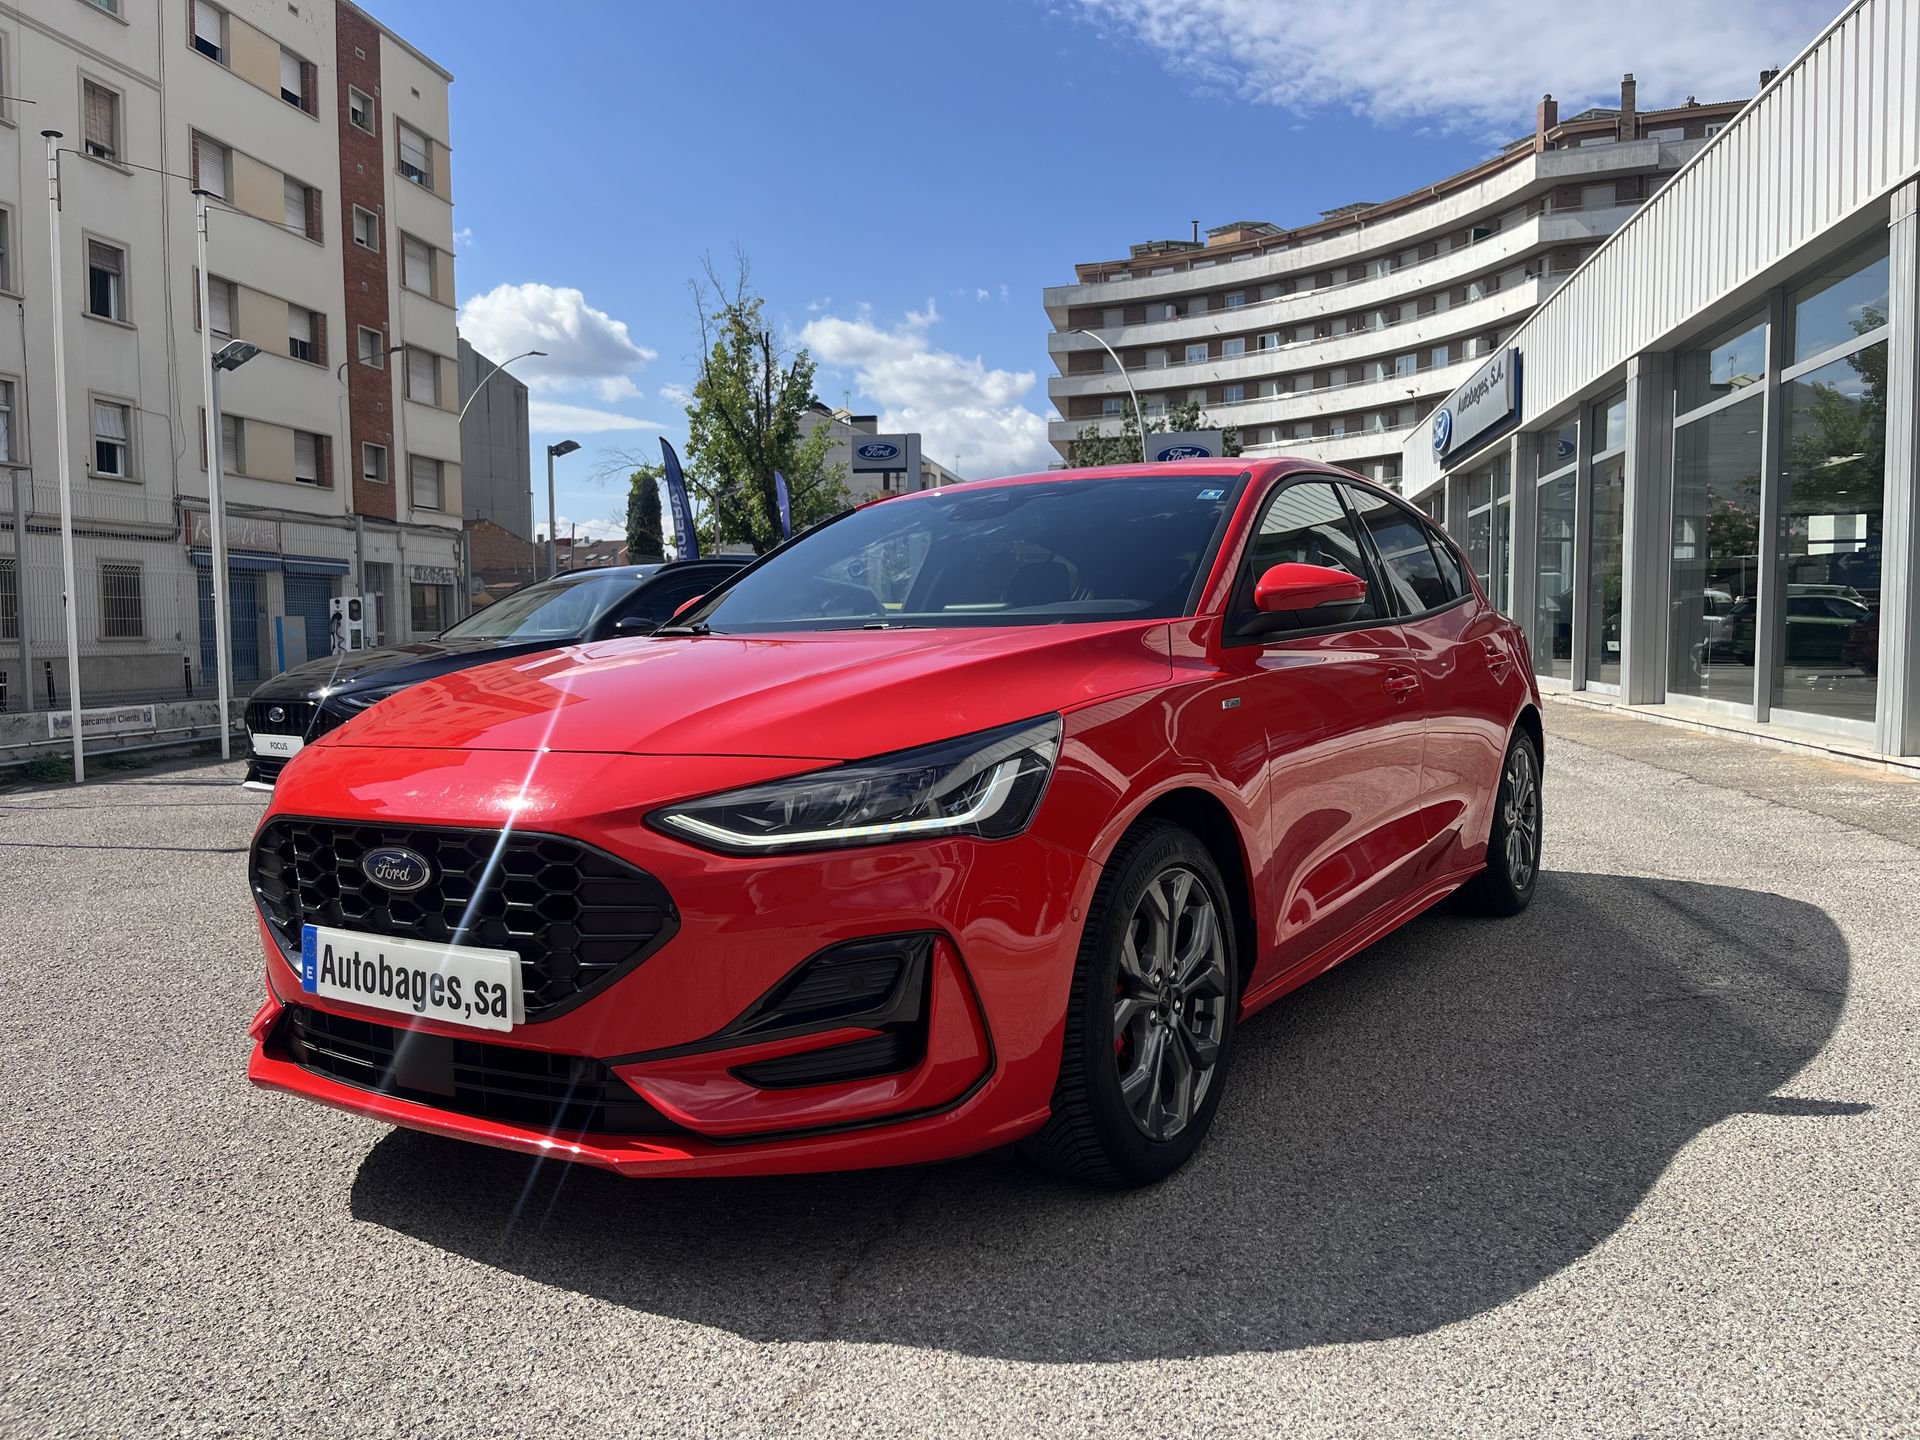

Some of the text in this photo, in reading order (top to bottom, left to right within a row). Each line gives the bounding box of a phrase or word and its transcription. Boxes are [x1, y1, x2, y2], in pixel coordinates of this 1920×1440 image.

[864, 445, 892, 457] Ford
[80, 716, 117, 727] parcament
[117, 714, 140, 723] Clients
[270, 741, 288, 750] FOCUS
[375, 855, 411, 882] Ford
[306, 965, 314, 980] E
[320, 943, 508, 1019] Autobages,sa
